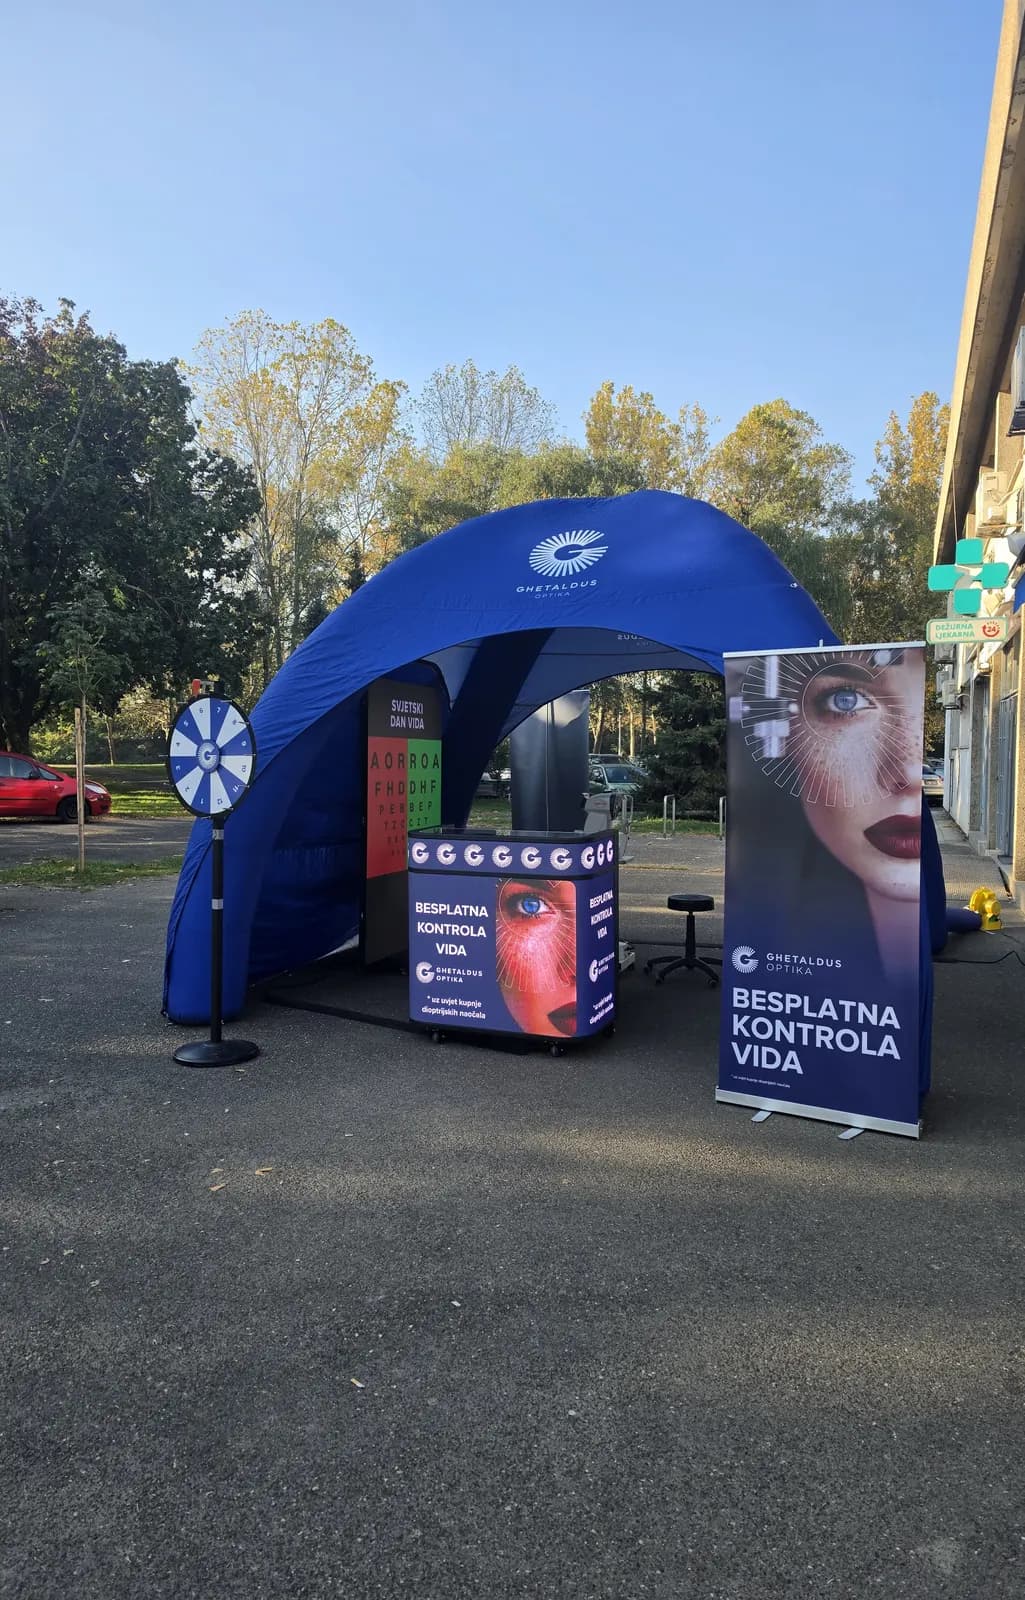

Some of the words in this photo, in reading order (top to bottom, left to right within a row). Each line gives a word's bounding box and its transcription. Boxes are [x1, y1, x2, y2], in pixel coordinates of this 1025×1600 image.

[516, 579, 598, 593] GHETALDUS
[534, 591, 570, 599] OPTIKA
[391, 699, 424, 715] SVJETSKI
[390, 715, 406, 728] DAN
[408, 717, 425, 730] VIDA
[415, 902, 489, 918] BESPLATNA
[417, 922, 487, 938] KONTROLA
[435, 942, 467, 956] VIDA
[766, 952, 842, 968] GHETALDUS
[436, 967, 483, 977] GHETALDUS
[766, 963, 813, 976] OPTIKA
[436, 975, 463, 983] OPTIKA
[441, 997, 457, 1006] uvjet
[458, 998, 482, 1009] kupnje
[732, 987, 901, 1030] BESPLATNA
[421, 1005, 458, 1017] dioptrijskih
[459, 1009, 486, 1019] naočala
[732, 1014, 901, 1060] KONTROLA
[731, 1041, 804, 1075] VIDA
